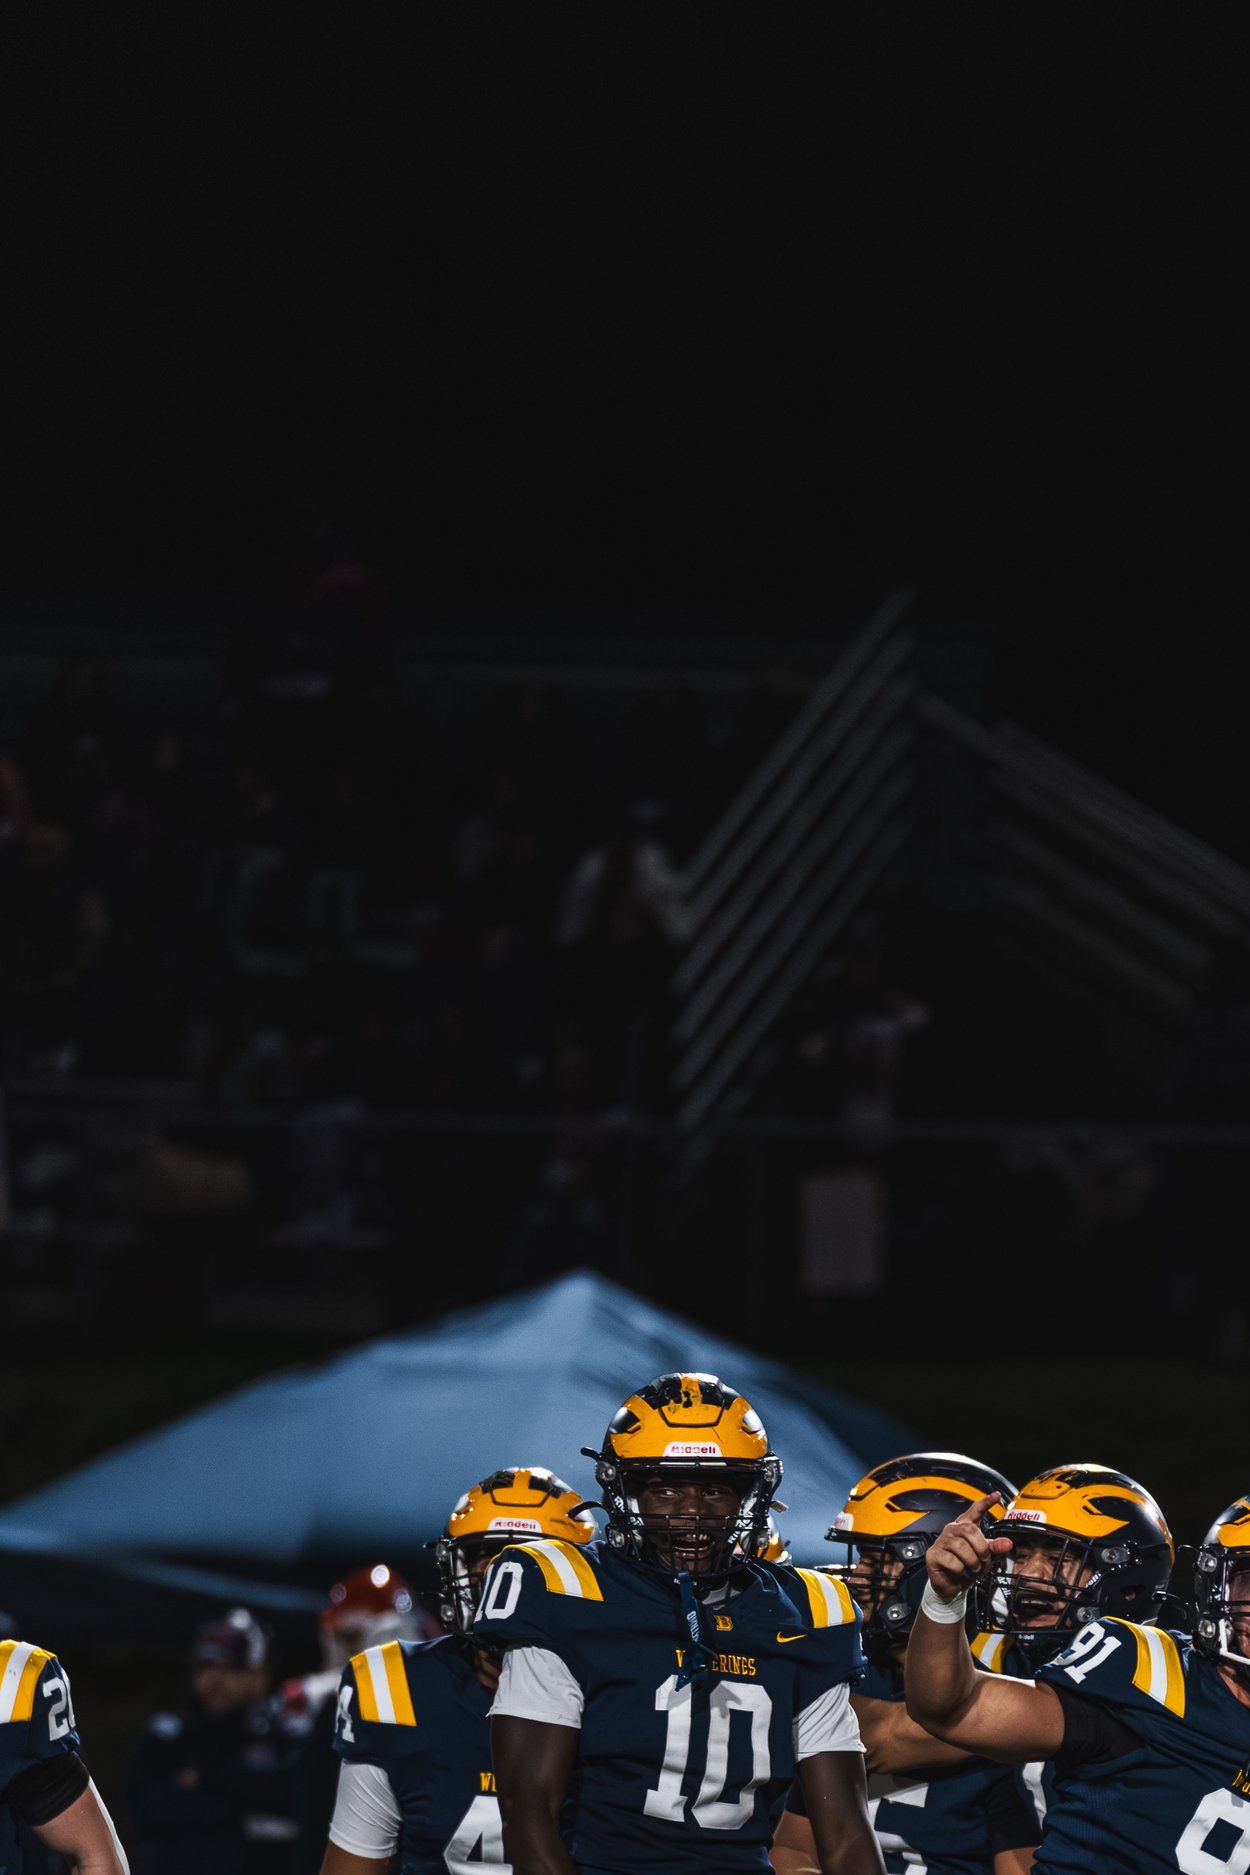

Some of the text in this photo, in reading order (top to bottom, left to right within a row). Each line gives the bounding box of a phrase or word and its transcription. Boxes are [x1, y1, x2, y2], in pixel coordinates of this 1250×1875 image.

[473, 1561, 524, 1624] 10
[1051, 1621, 1123, 1685] 91
[643, 1674, 773, 1831] 10
